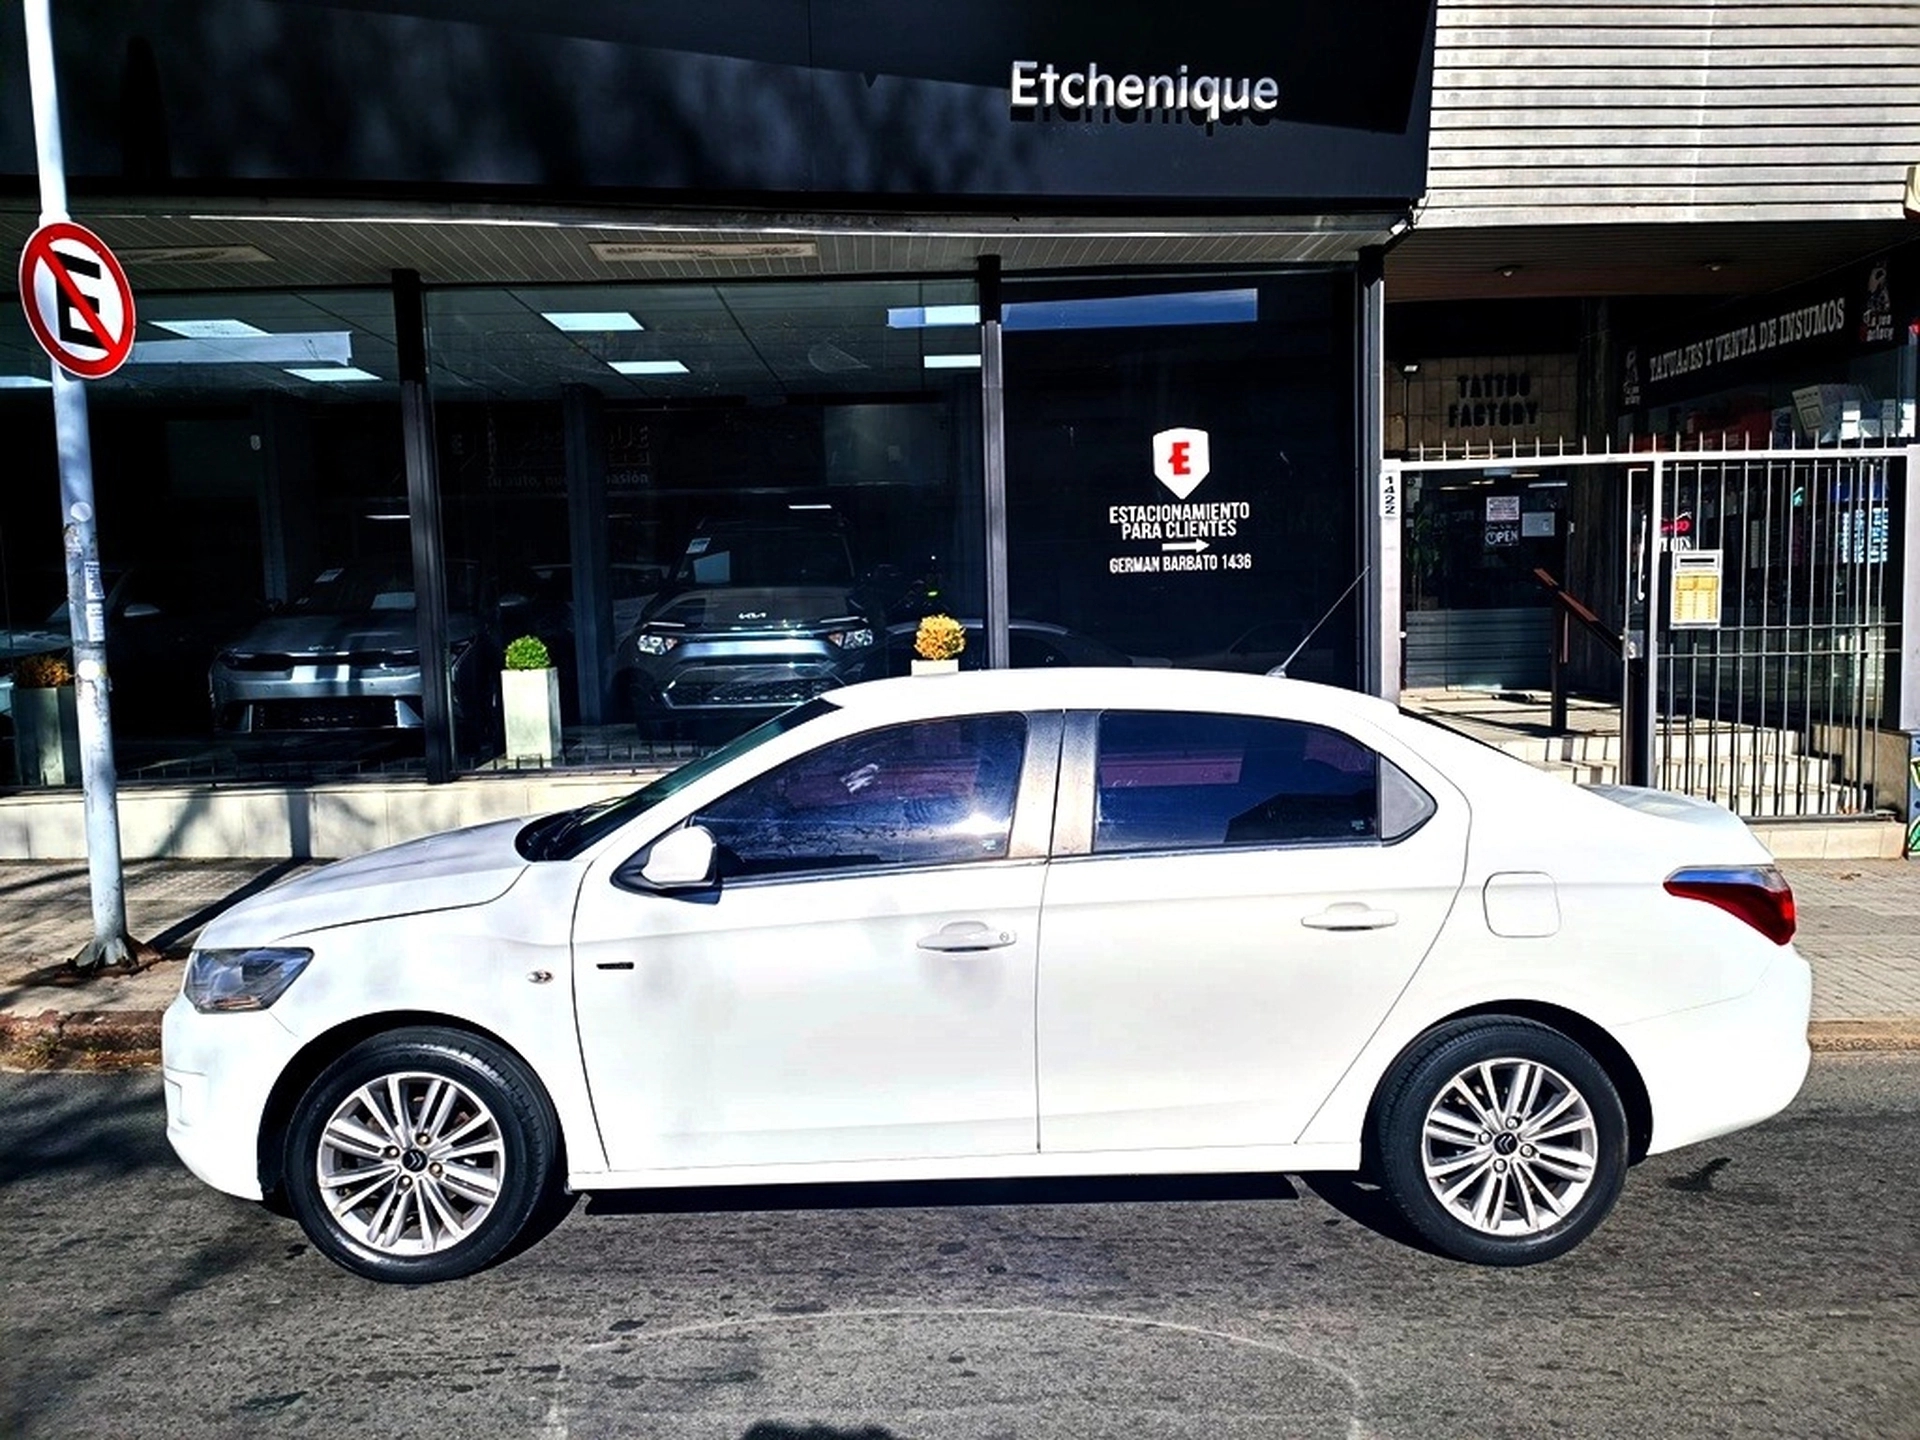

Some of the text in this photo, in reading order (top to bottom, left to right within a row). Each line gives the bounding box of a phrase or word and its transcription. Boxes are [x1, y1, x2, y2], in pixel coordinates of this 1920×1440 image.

[1011, 60, 1279, 121] Etchenique
[54, 250, 107, 349] E
[1649, 296, 1846, 382] TATUAJES Y VENTA DE INSUMOS
[1457, 373, 1531, 398] TATTOO
[1449, 402, 1538, 428] FACTORY
[1384, 475, 1396, 514] 1422
[1109, 502, 1250, 524] ESTACIONAMIENTO
[1122, 519, 1237, 540] PARA CLIENTES
[1485, 529, 1518, 546] OPEN
[1109, 553, 1252, 574] GERMAN BARBATO 1436
